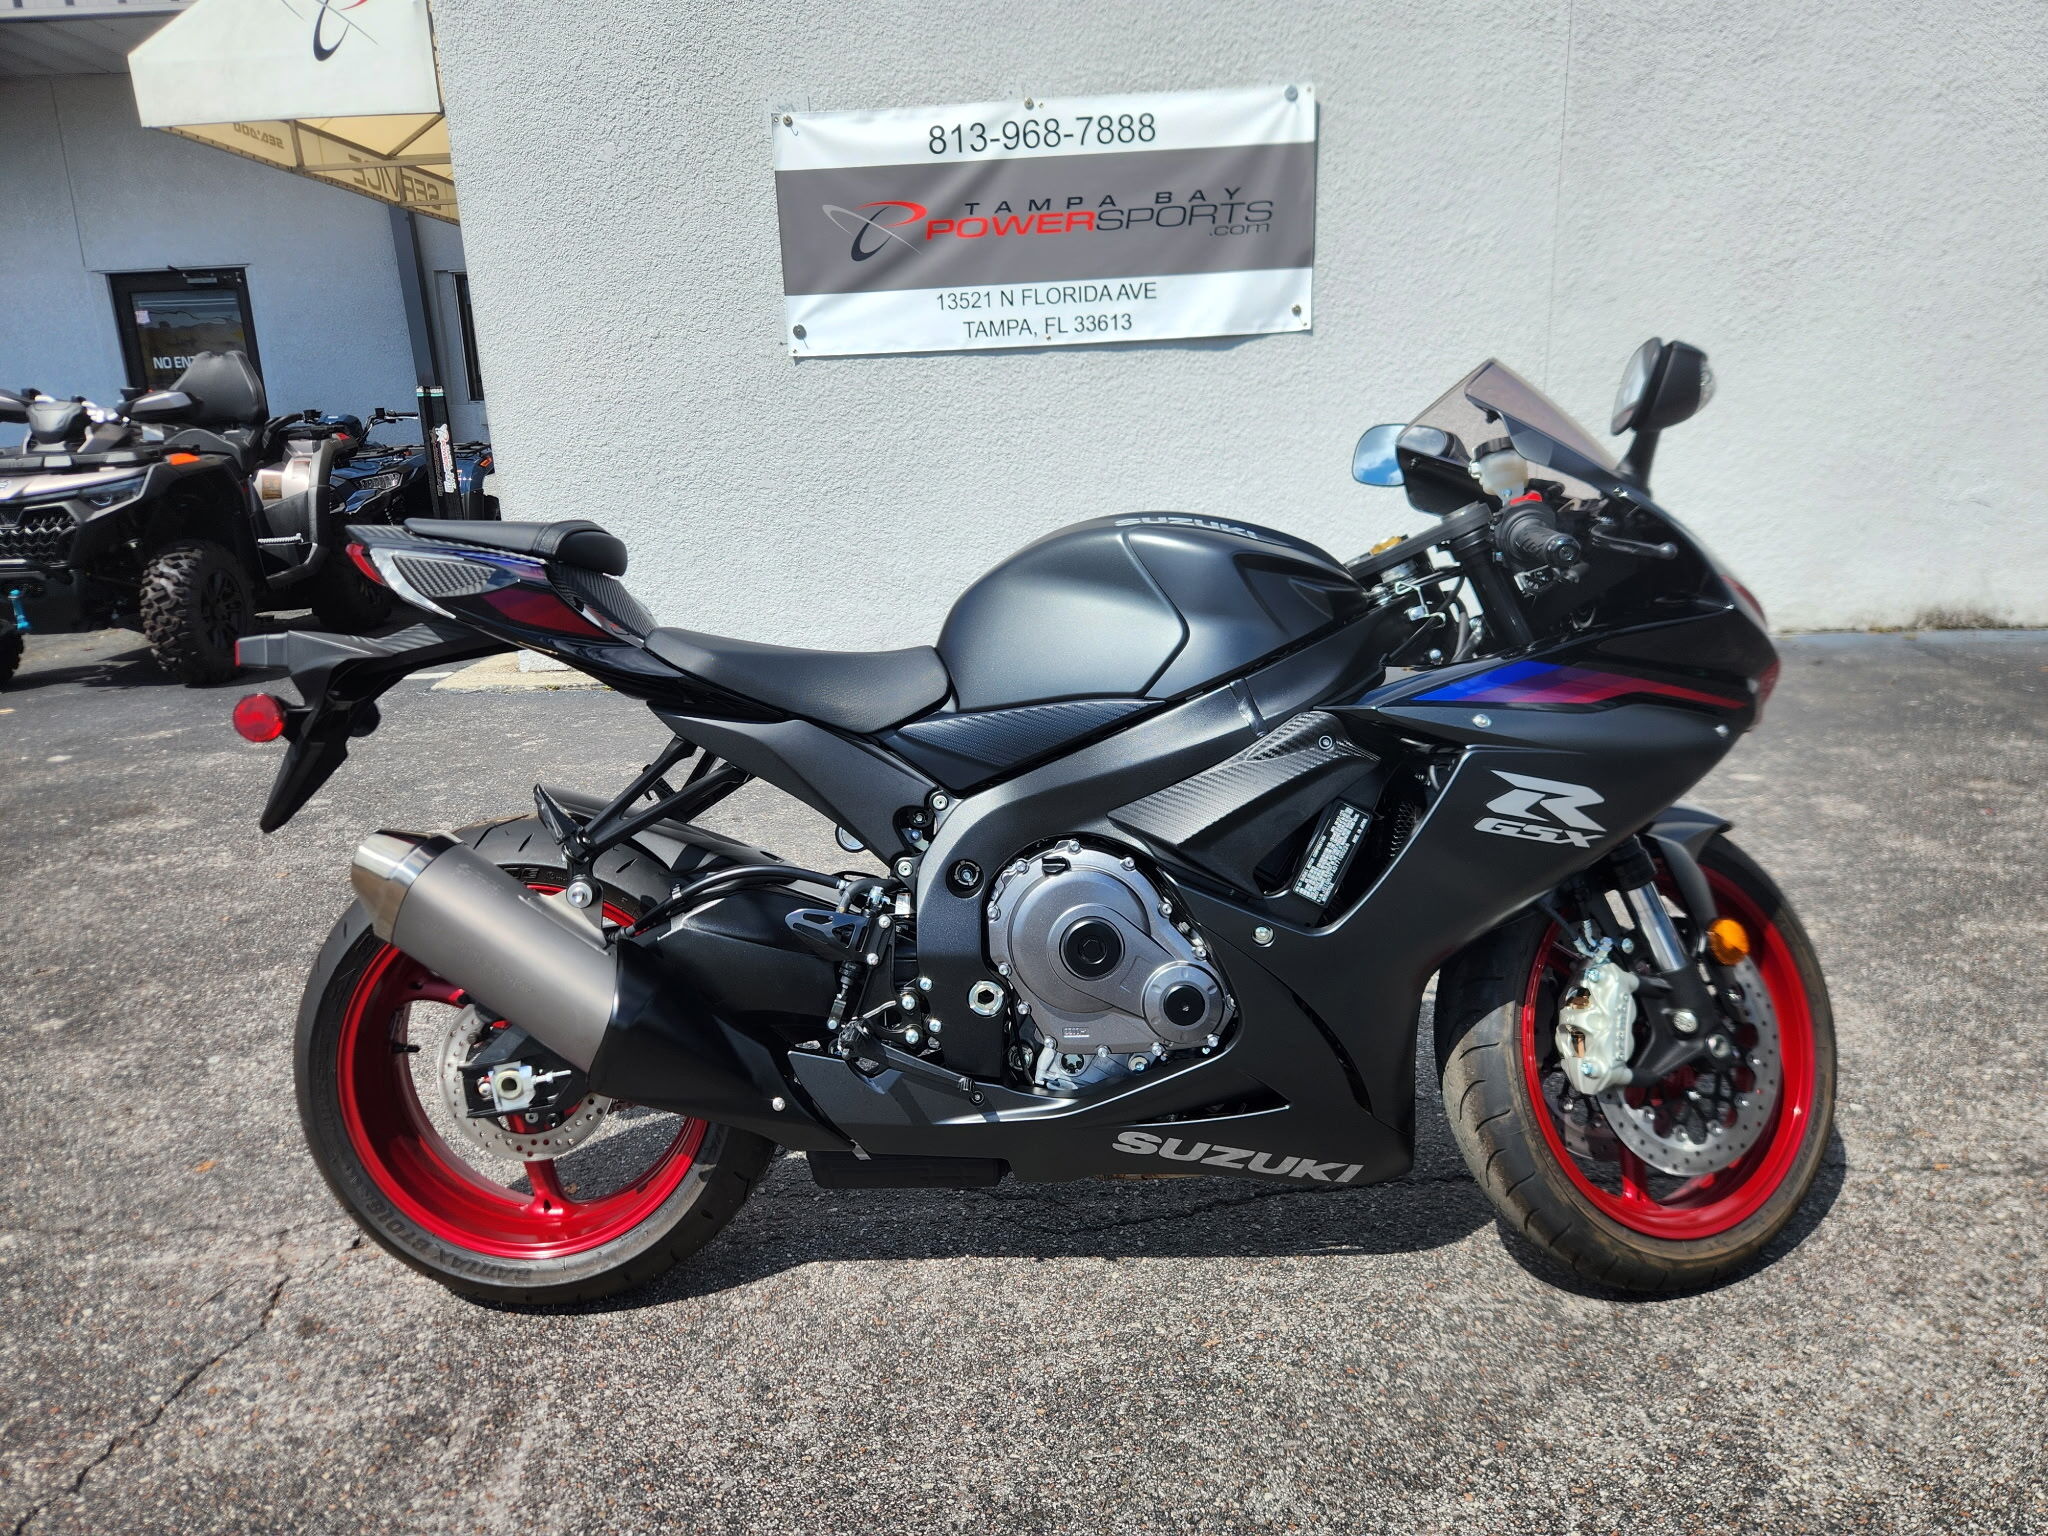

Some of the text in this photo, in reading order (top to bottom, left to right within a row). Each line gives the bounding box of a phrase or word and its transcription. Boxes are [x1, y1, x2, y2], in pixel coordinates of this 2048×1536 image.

[929, 112, 1156, 155] 813-968-7888
[964, 186, 1242, 216] TAMPA BAY
[925, 200, 1274, 241] POWERSPORTS
[1209, 222, 1271, 238] .com
[937, 281, 1158, 311] 13521 N FLORIDA AVE
[963, 312, 1133, 339] TAMPA, FL 33613
[152, 356, 172, 369] NO
[1115, 516, 1259, 540] SUZUKI
[1486, 769, 1608, 832] R
[1473, 817, 1606, 848] GSX
[1112, 1131, 1364, 1183] SUZUKI
